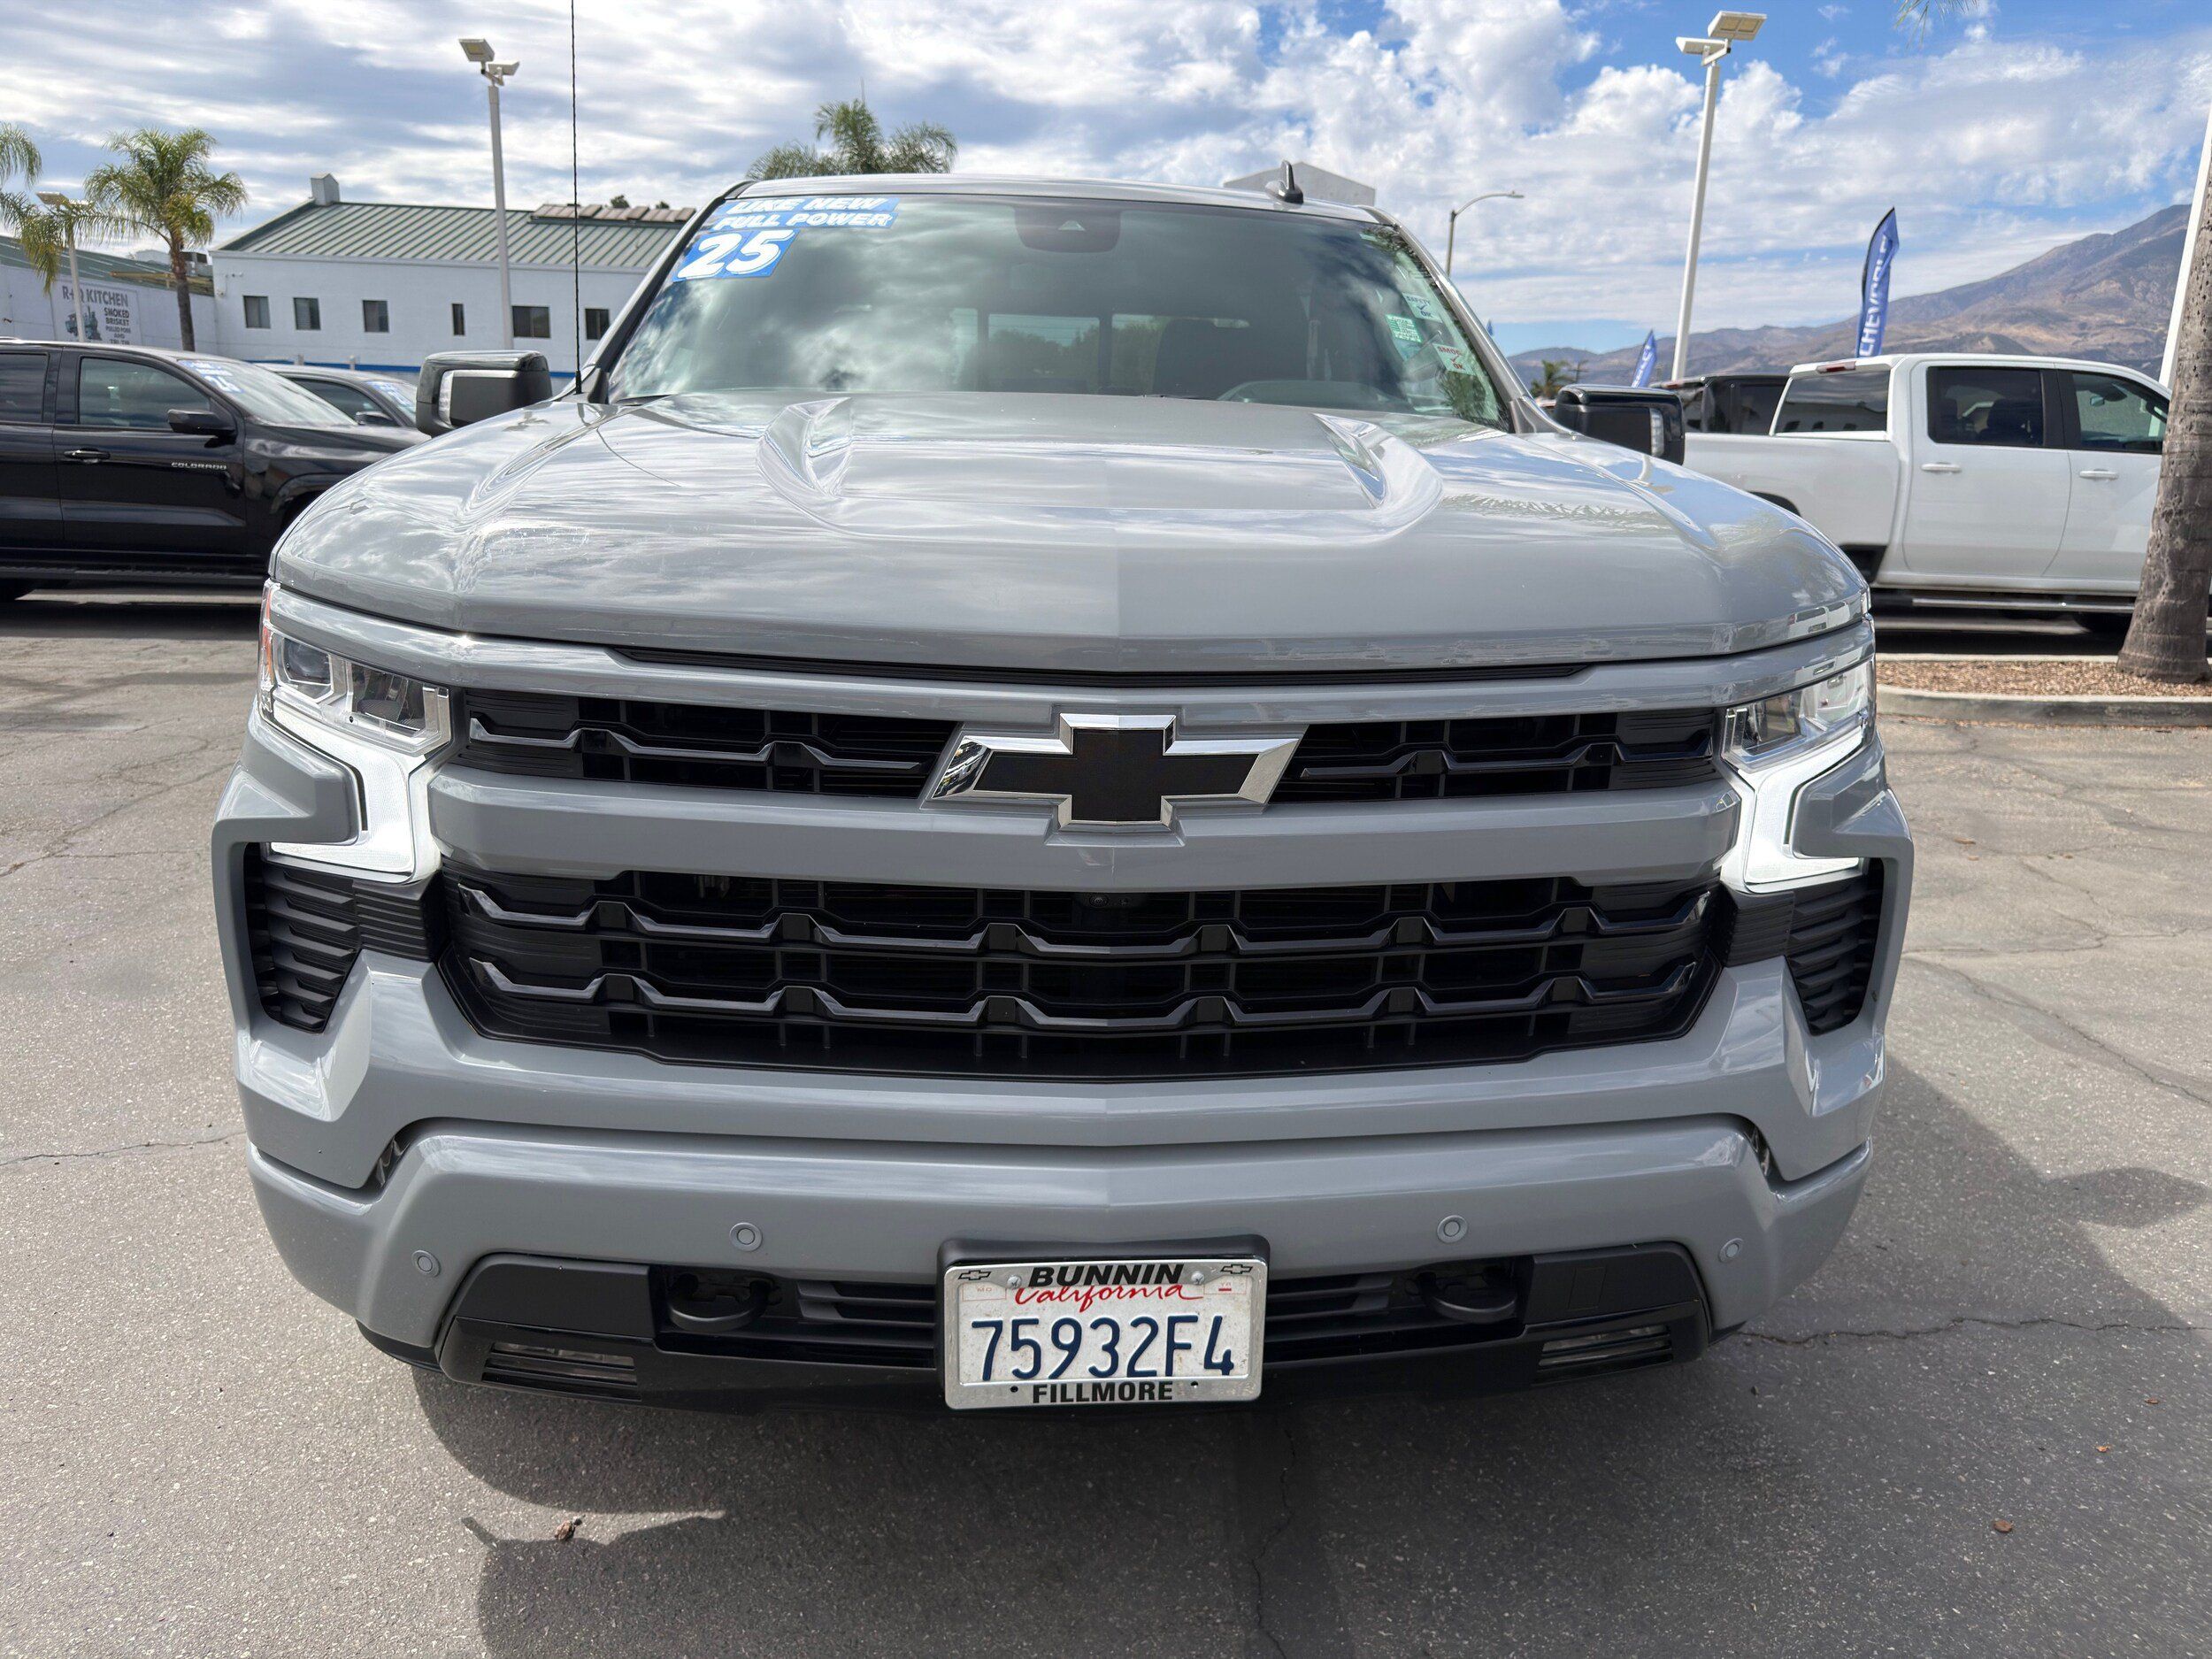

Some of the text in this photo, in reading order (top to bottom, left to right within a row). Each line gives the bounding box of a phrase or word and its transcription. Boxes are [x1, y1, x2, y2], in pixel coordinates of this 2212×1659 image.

[726, 197, 889, 214] LIKE NEW
[713, 212, 894, 230] FULL POWER
[677, 229, 795, 279] 25
[86, 288, 129, 307] KITCHEN
[104, 307, 130, 319] SMOKED
[105, 317, 130, 326] BRISKET
[171, 462, 227, 471] COLORADO
[1028, 1263, 1185, 1286] BUNNIN
[1015, 1284, 1204, 1313] California
[972, 1315, 1235, 1382] 75932F4
[1033, 1380, 1173, 1404] FILLMORE
